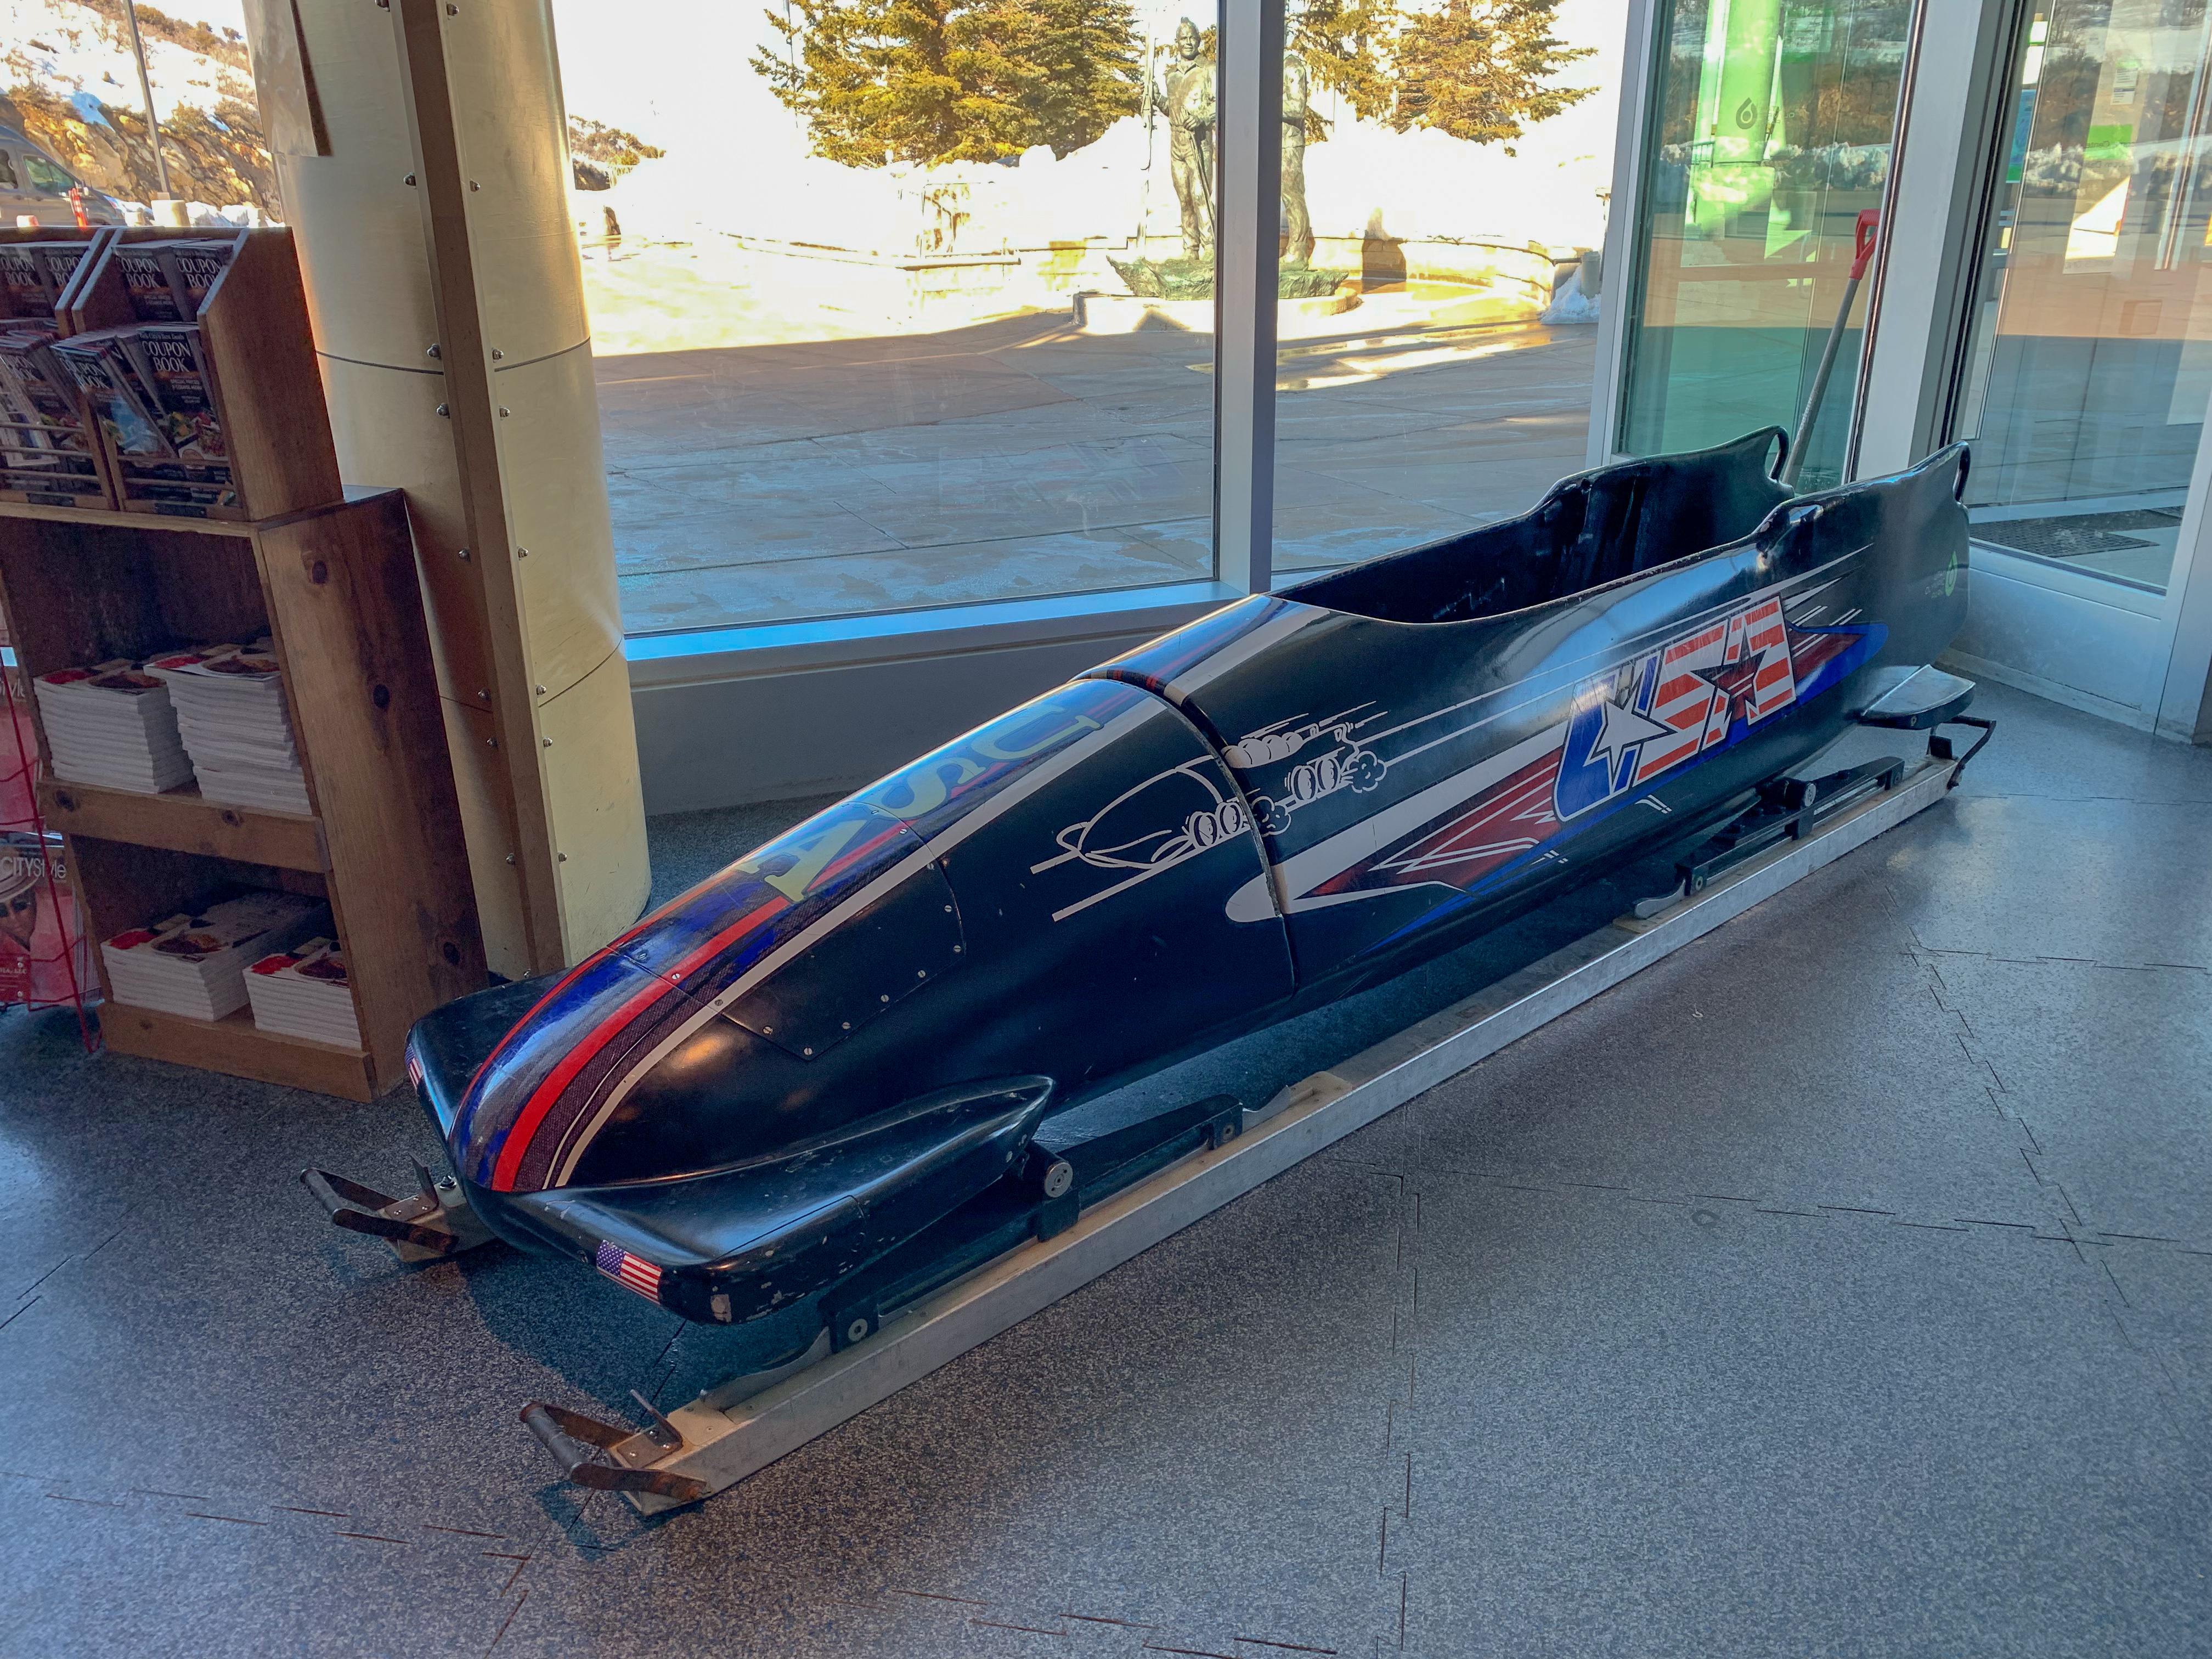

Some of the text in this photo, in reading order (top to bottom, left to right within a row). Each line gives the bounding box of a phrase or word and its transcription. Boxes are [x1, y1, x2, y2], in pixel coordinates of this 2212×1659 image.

[0, 257, 35, 272] OUPON
[5, 272, 36, 286] BOOK
[126, 273, 160, 288] BOOK
[142, 341, 191, 357] COUPON
[153, 357, 190, 373] BOOK
[1553, 596, 1797, 822] USA
